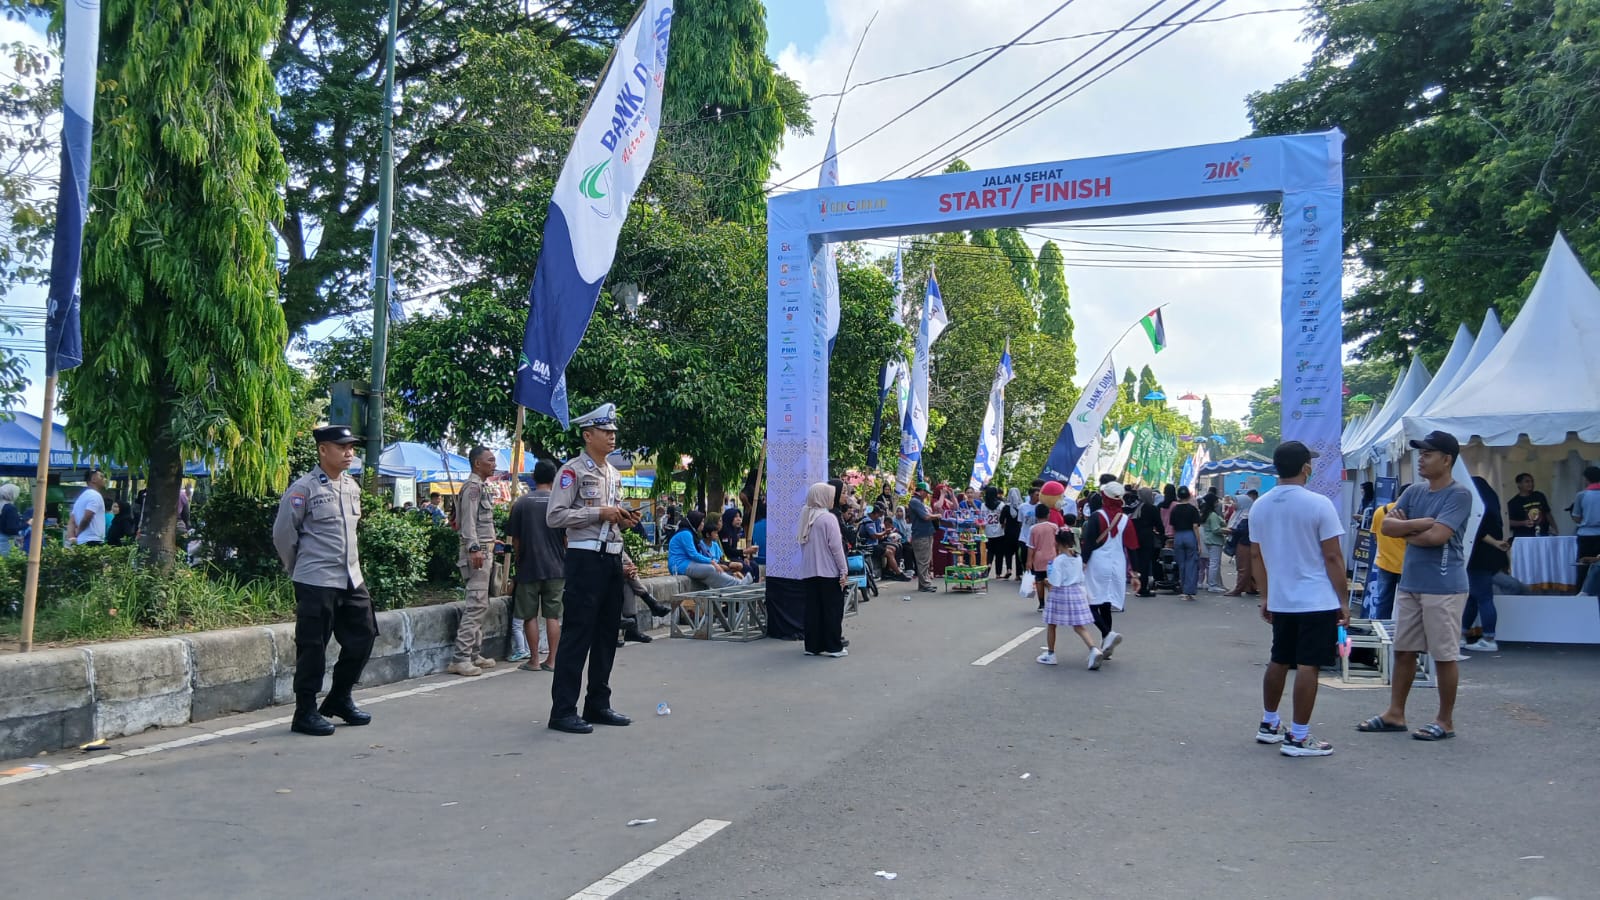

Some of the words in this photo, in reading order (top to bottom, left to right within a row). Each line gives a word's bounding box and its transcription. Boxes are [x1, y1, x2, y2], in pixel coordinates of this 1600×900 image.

[600, 82, 643, 153] BANK
[982, 173, 1021, 187] JALAN
[1024, 169, 1063, 183] SEHAT
[1030, 177, 1111, 204] FINISH
[1086, 387, 1103, 410] BANK
[987, 514, 999, 525] 23
